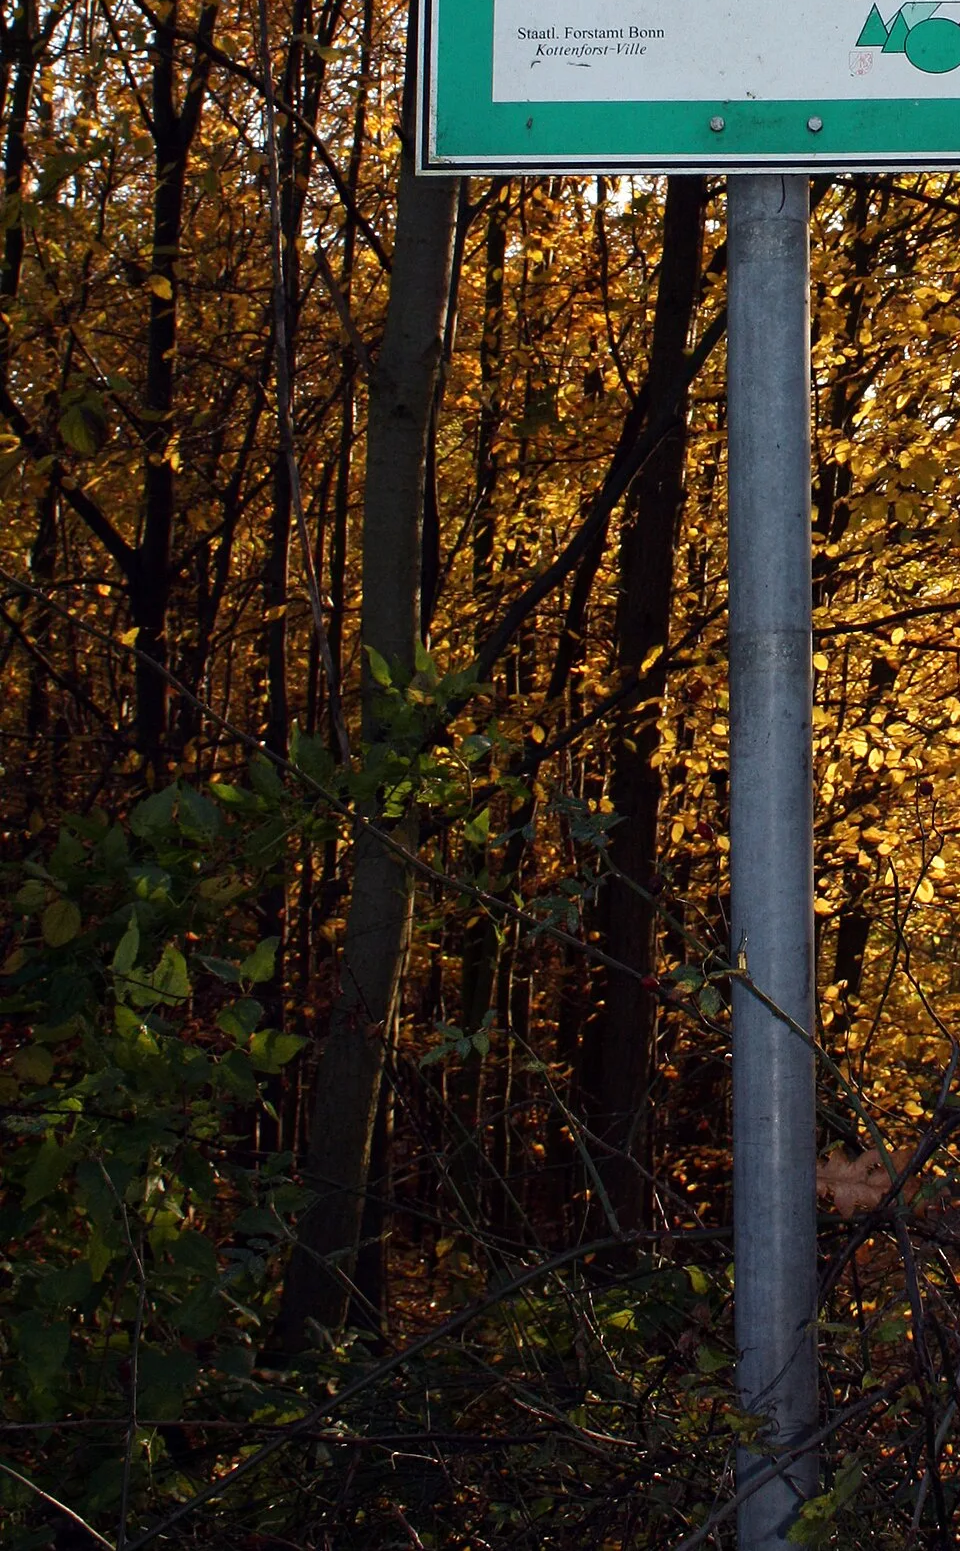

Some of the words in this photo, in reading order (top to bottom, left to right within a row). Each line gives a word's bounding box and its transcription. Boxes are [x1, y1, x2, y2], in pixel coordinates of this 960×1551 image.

[517, 27, 559, 39] Staatl.
[565, 27, 624, 39] Forstamt
[629, 26, 665, 38] Bonn
[535, 43, 647, 58] Kottenforst-Ville
